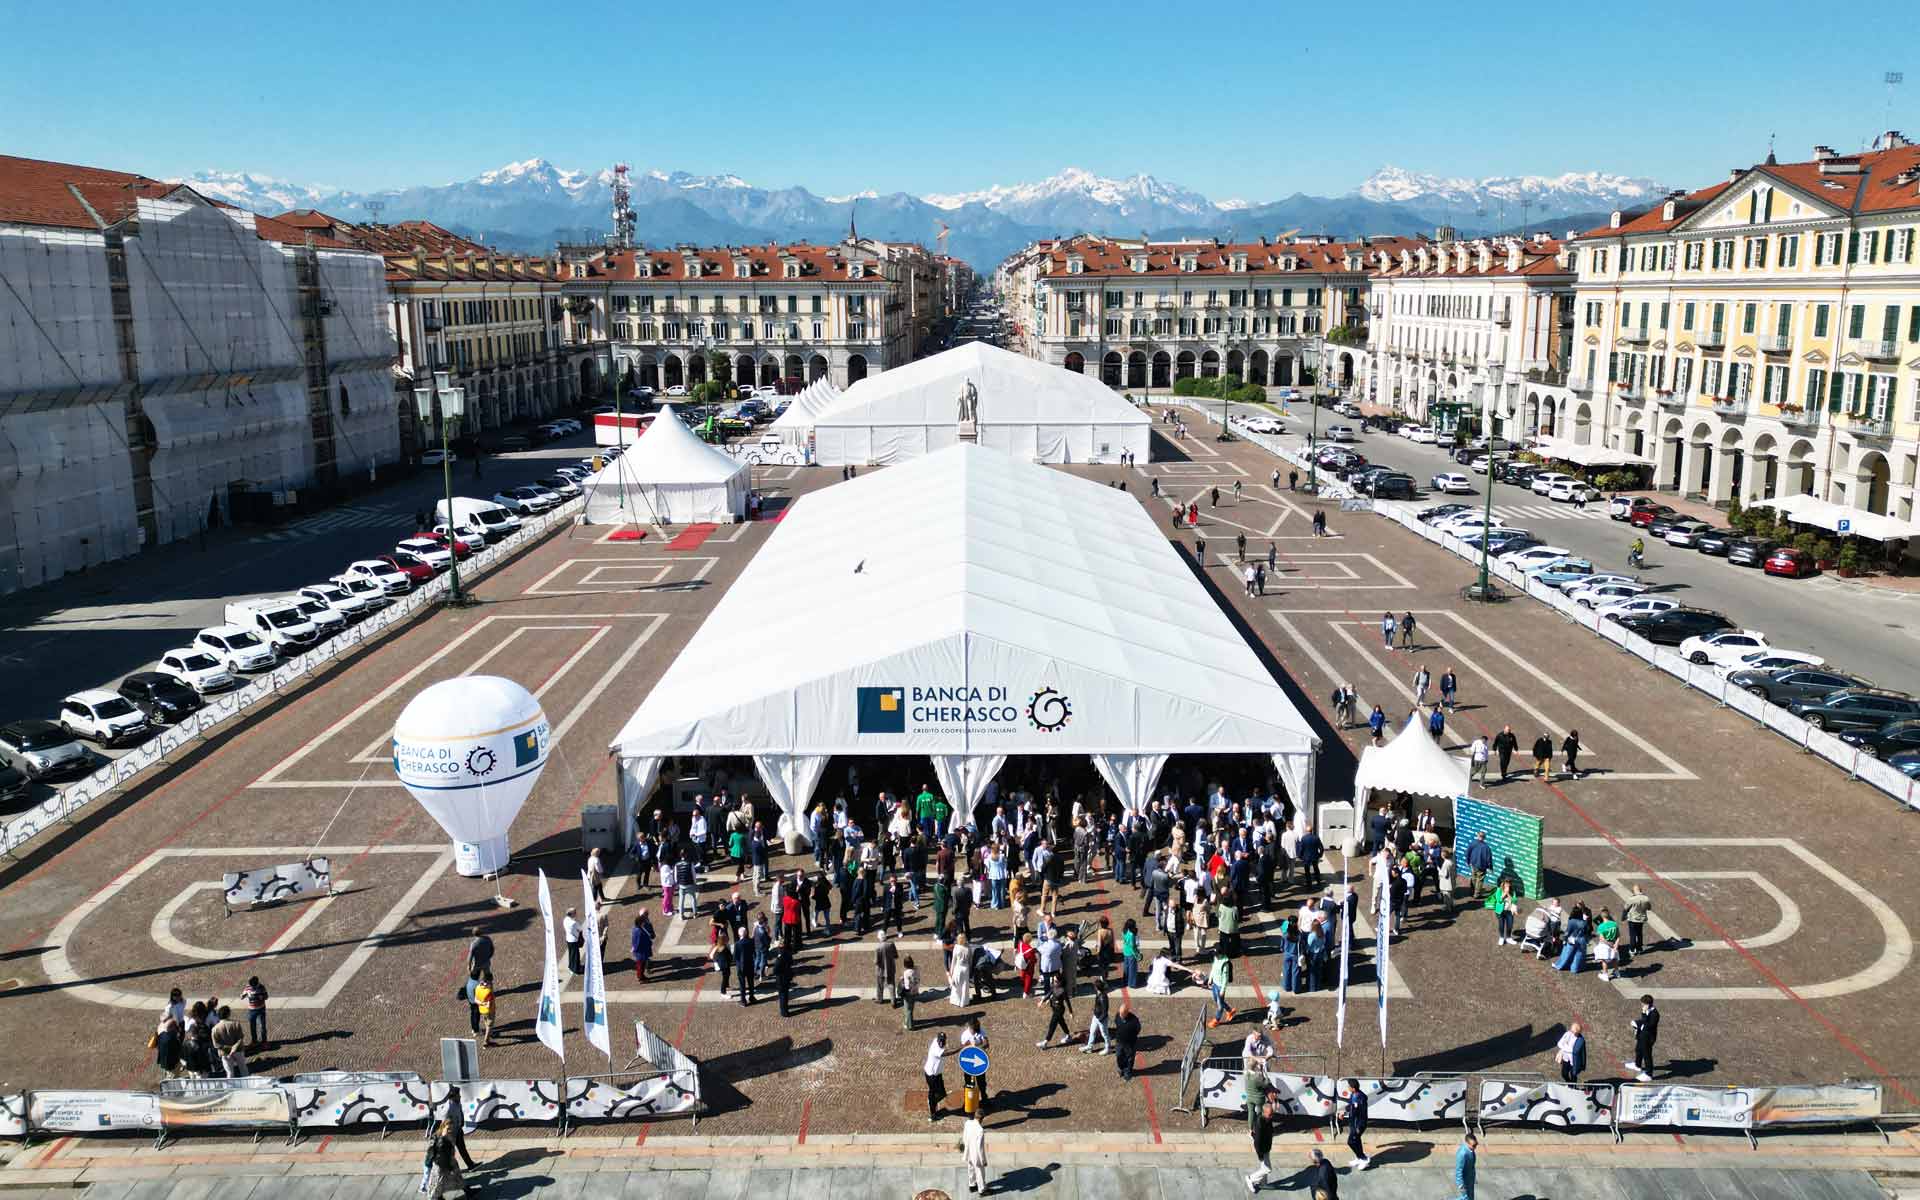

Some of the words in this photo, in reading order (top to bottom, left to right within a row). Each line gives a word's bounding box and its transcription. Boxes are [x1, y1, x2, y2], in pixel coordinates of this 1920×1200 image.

[912, 687, 982, 702] BANCA
[988, 687, 1007, 702] DI
[912, 707, 1018, 722] CHERASCO
[401, 744, 435, 759] BANCA
[439, 747, 451, 759] DI
[401, 759, 460, 774] CHERASCO
